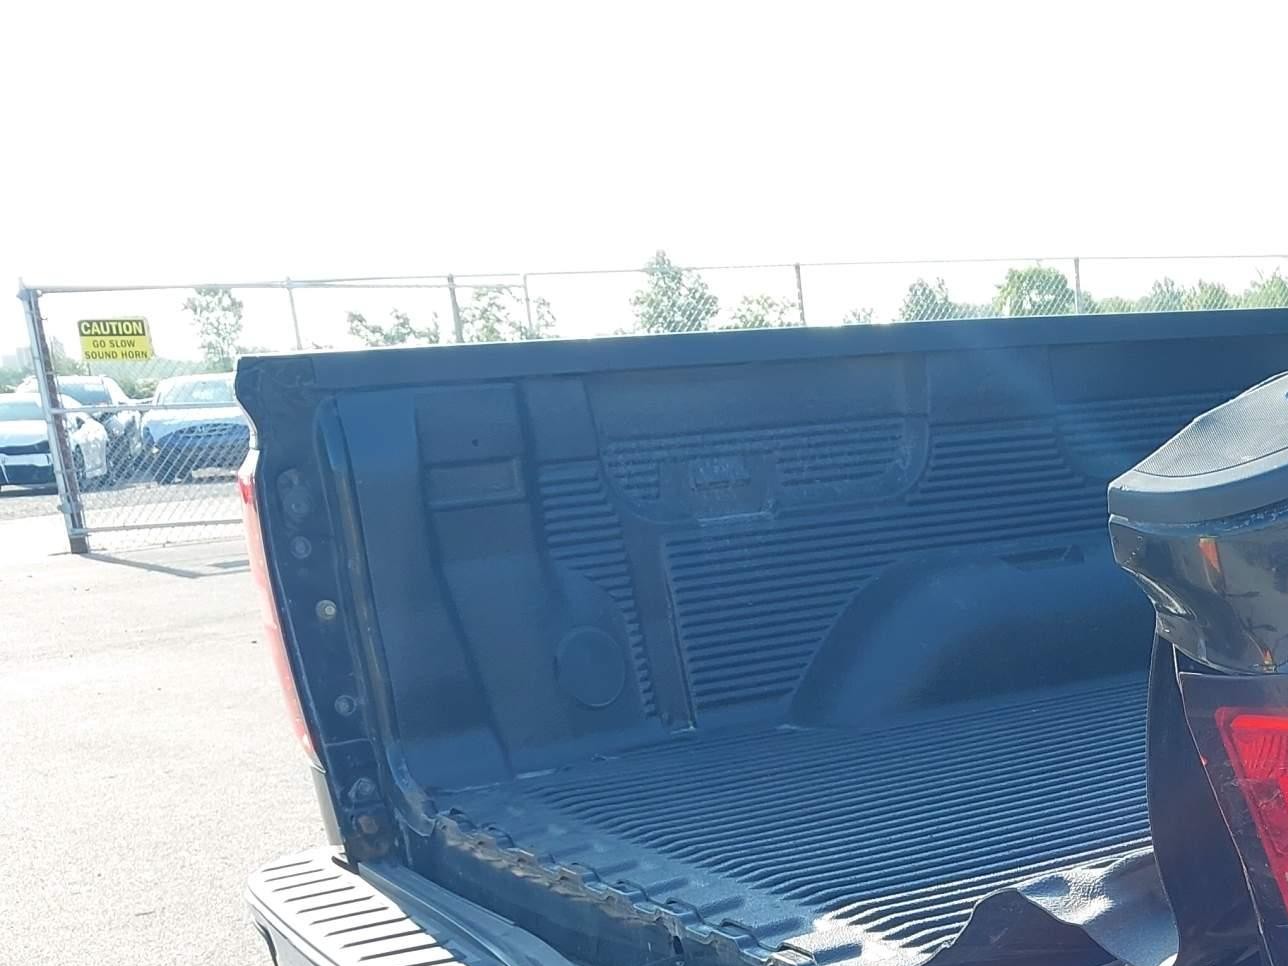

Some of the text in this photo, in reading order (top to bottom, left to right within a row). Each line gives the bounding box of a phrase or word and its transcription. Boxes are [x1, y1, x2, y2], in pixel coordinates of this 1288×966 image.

[80, 321, 143, 335] CAUTION
[92, 339, 135, 349] GO SLOW
[84, 350, 148, 360] SOUND HORN
